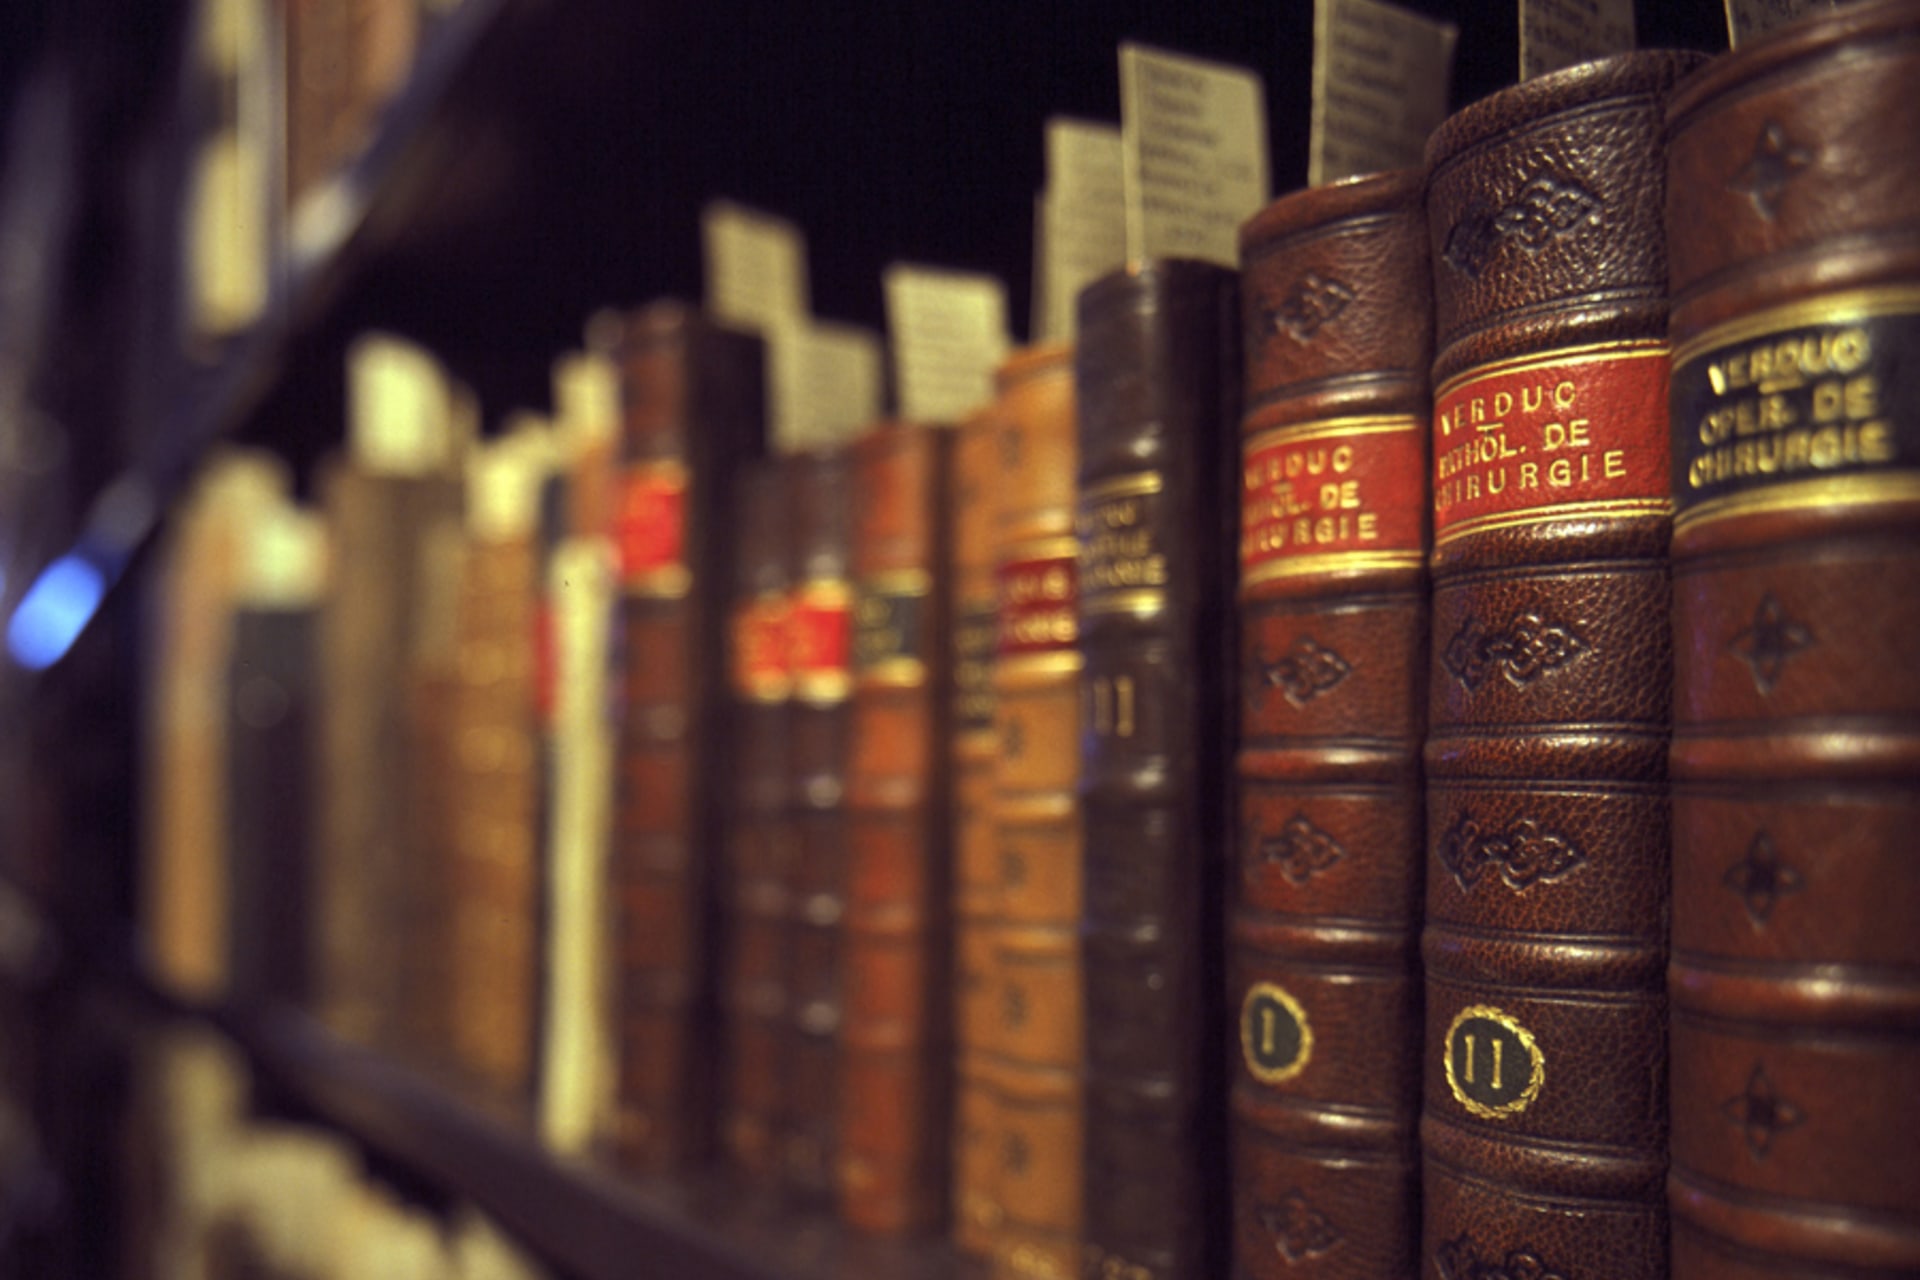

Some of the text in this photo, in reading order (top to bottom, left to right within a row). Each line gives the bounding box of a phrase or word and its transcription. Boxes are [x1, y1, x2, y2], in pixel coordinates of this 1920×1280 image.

[1441, 381, 1576, 436] VERDUC
[1813, 376, 1878, 421] DE
[1543, 419, 1591, 450] DE
[1320, 480, 1361, 510] DE
[1464, 1034, 1502, 1089] II
